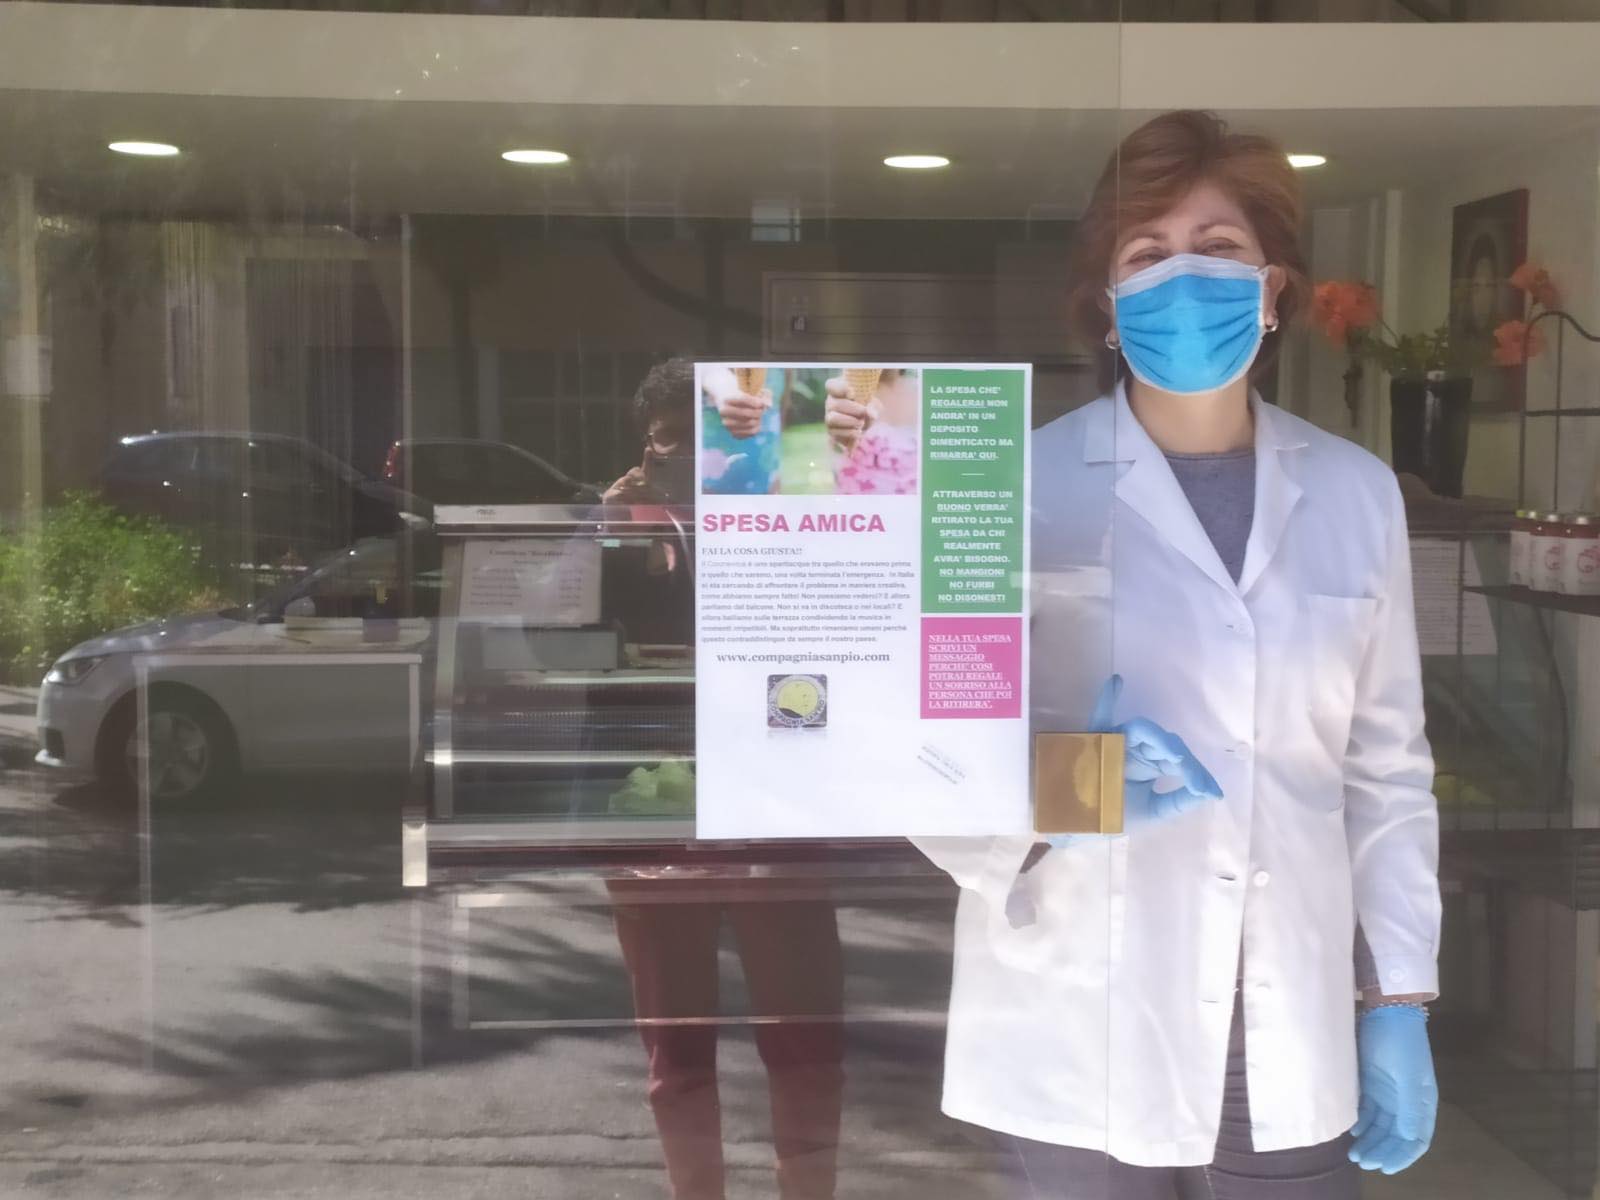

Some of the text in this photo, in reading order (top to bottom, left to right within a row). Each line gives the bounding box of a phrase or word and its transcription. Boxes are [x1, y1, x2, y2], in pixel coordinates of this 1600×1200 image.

[930, 386, 943, 394] LA
[945, 386, 976, 394] SPESA
[930, 399, 1008, 407] REGALERAI NON
[968, 412, 980, 420] IN
[981, 412, 996, 420] UN
[930, 425, 979, 433] DEPOSITO
[930, 438, 1014, 446] DIMENTICATO MA
[930, 451, 1000, 459] RIMARRA' QUI.
[932, 490, 1013, 498] ATTRAVERSO UN
[937, 503, 971, 511] BUONO
[702, 513, 886, 532] SPESA AMICA
[939, 529, 1005, 537] SPESA DA CHI
[944, 542, 1001, 550] REALMENTE
[702, 547, 717, 556] FAI
[720, 547, 732, 556] LA
[733, 547, 759, 556] COSA
[934, 555, 1011, 563] AVRA' BISOGNO.
[939, 568, 1005, 576] NO MANGIONI
[949, 581, 994, 589] NO FURBI
[938, 593, 1005, 601] NO DISONESTI
[928, 634, 1012, 642] NELLA TUA SPESA
[929, 644, 976, 652] SCRIVI UN
[716, 652, 890, 664] www.compagniasanpio.com
[929, 653, 985, 661] MESSAGGIO
[929, 672, 963, 680] POTRAI
[929, 681, 1012, 689] UN SORRISO ALLA
[929, 690, 1012, 698] PERSONA CHE POI
[929, 700, 942, 708] LA
